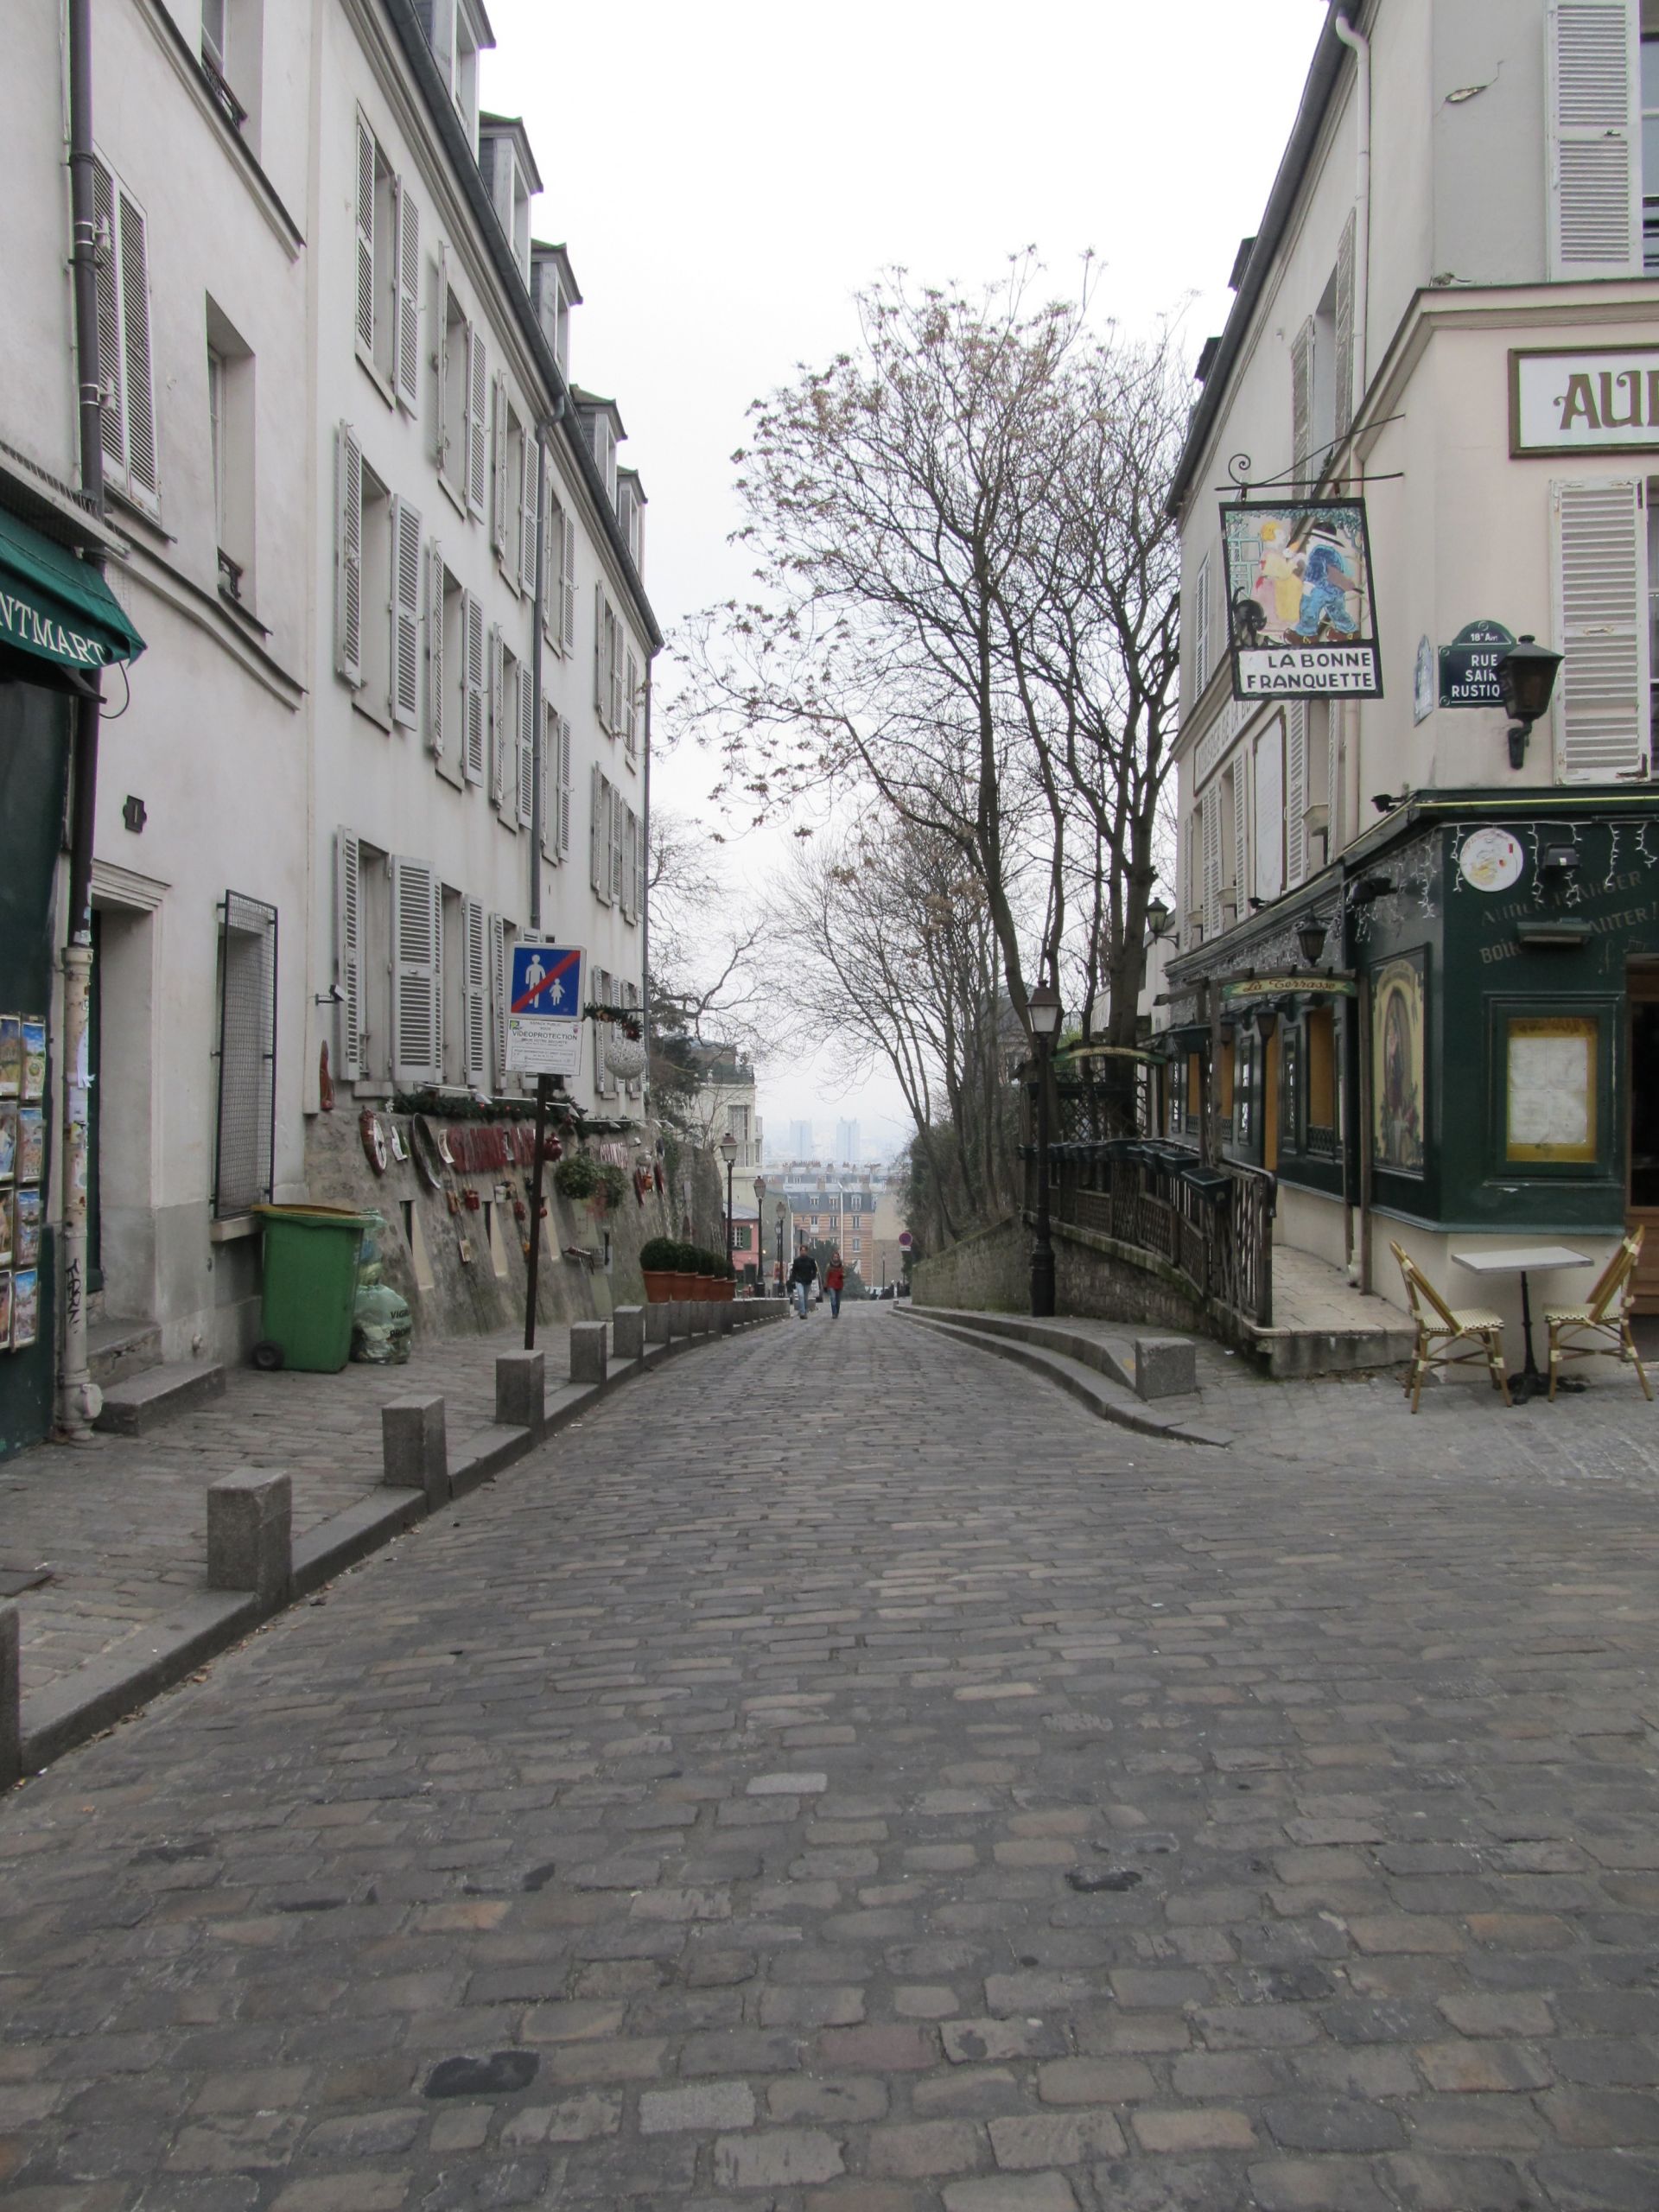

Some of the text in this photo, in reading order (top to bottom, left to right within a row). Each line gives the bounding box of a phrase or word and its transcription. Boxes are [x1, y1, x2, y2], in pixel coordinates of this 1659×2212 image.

[1268, 652, 1371, 668] LA BONNE
[1471, 654, 1498, 667] RUE
[1247, 672, 1372, 690] FRANQUETTE
[1243, 978, 1336, 993] La Terrasse
